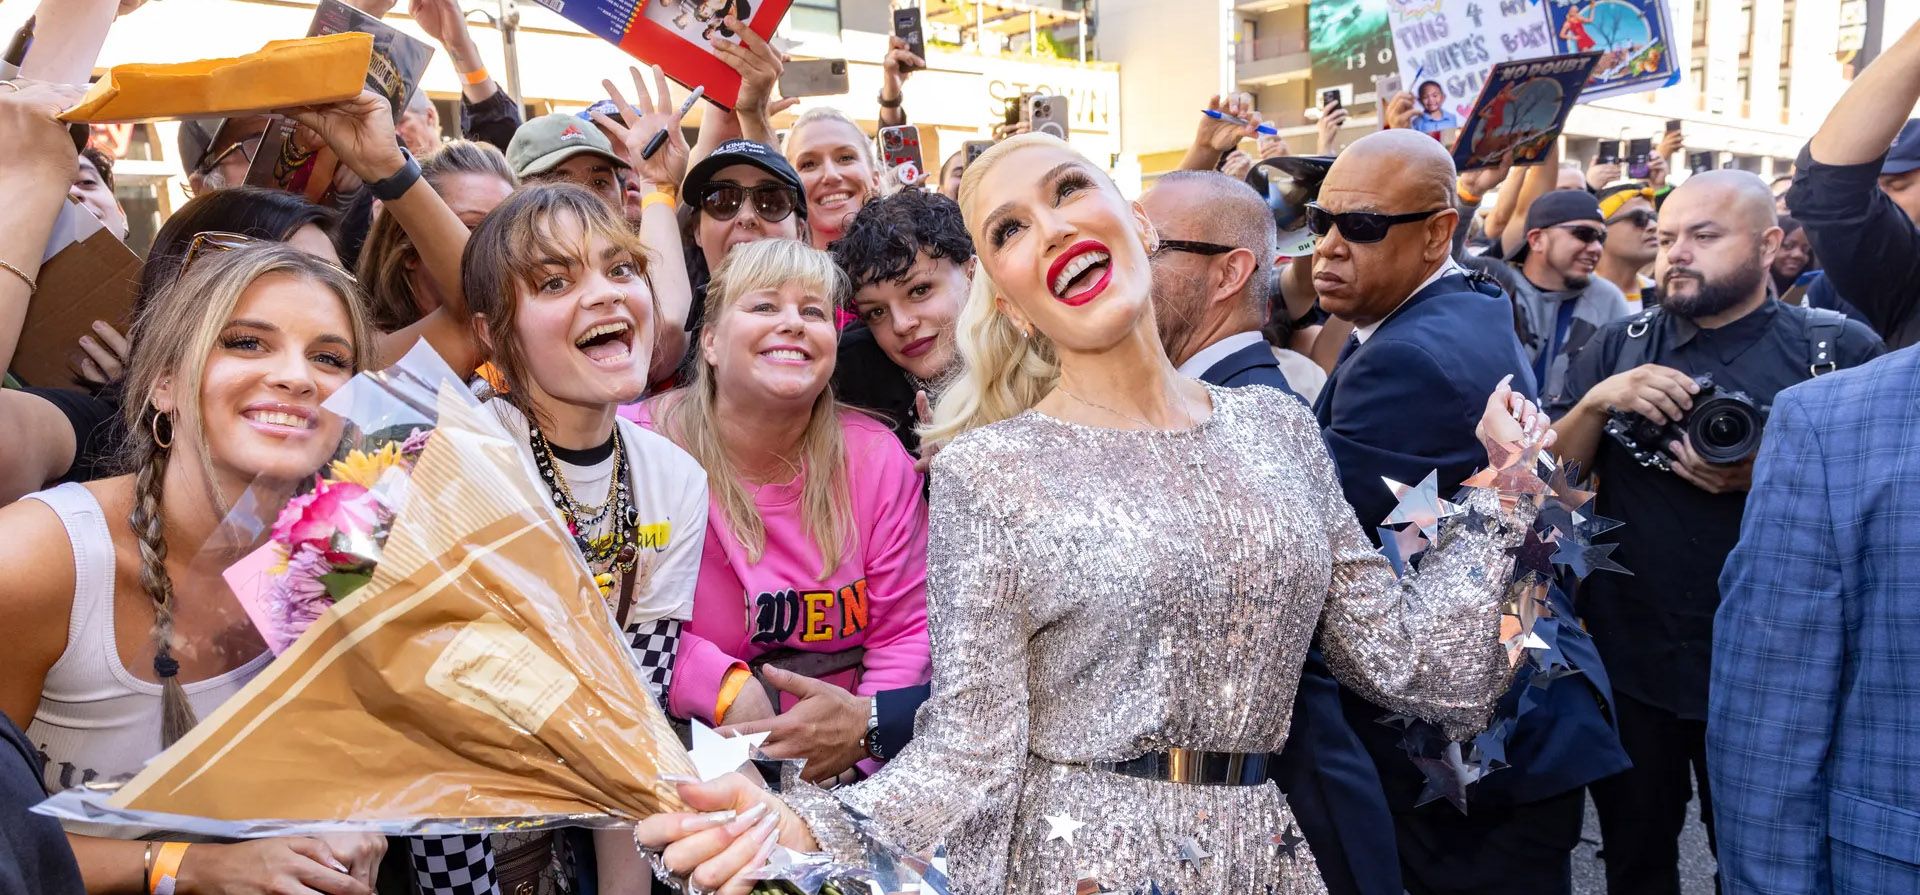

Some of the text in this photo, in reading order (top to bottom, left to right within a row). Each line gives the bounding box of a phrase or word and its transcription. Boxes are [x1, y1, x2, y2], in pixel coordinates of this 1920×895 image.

[1397, 14, 1449, 50] THIS
[1466, 2, 1483, 28] 4
[1407, 33, 1490, 80] WIFE'S
[1500, 57, 1592, 81] NO DOUBT
[744, 578, 869, 644] WEN
